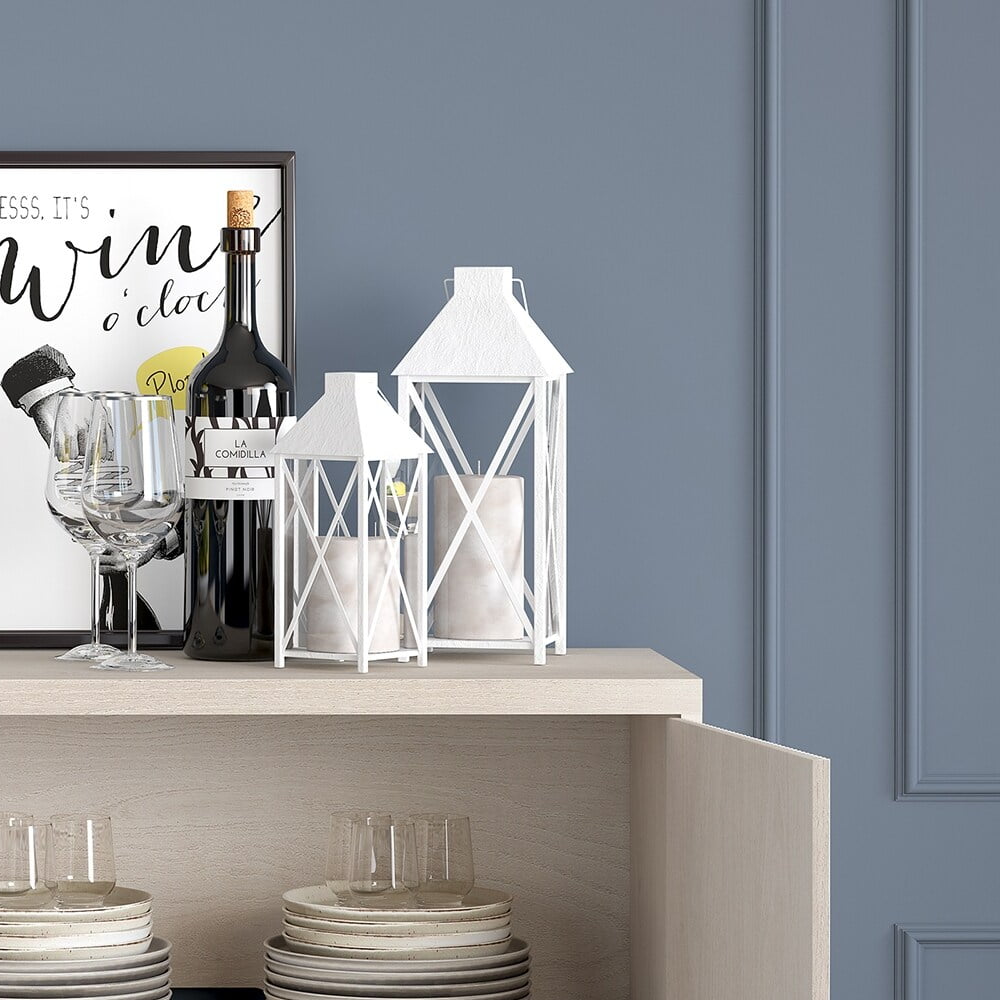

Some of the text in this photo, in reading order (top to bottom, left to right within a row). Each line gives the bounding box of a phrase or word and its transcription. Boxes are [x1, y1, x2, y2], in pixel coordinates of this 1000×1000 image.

[53, 196, 90, 220] IT'S
[234, 439, 248, 449] LA
[215, 449, 267, 459] COMIDILLA
